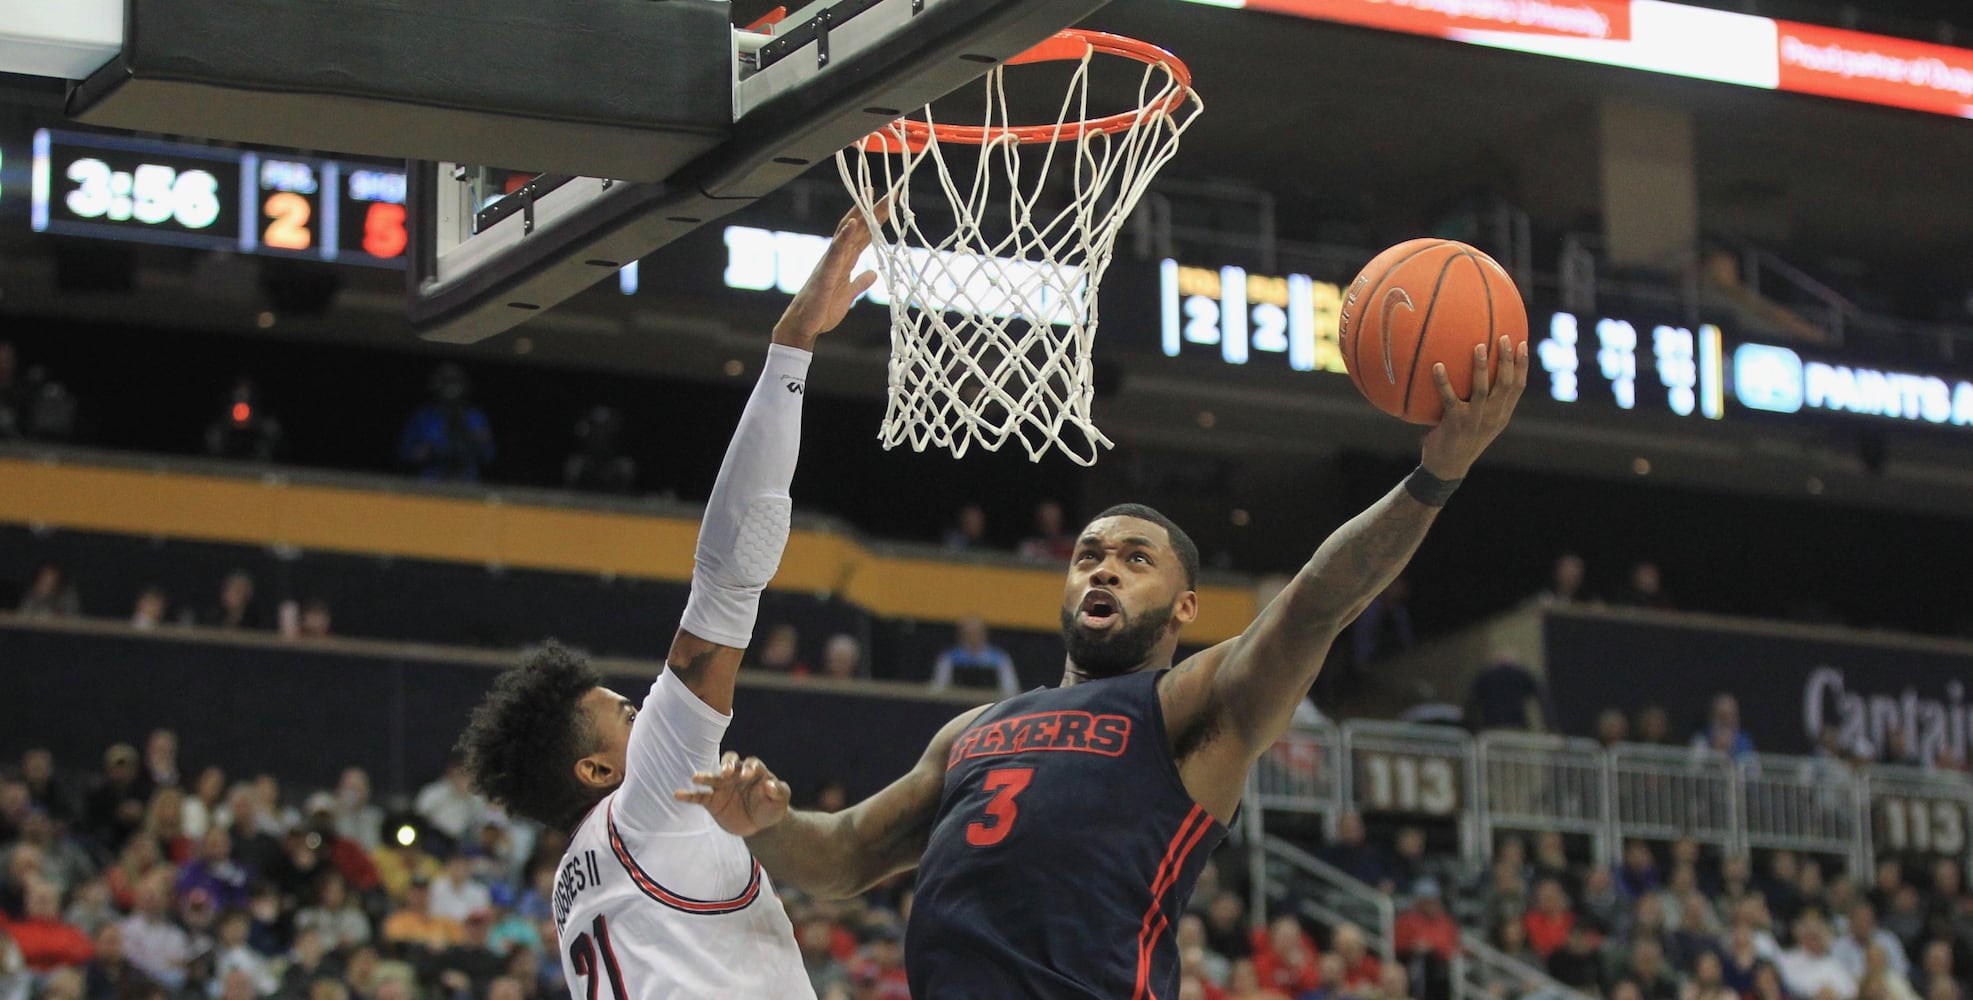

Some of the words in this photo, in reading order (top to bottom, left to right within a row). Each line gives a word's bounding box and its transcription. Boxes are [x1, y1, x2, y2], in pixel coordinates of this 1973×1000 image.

[66, 158, 220, 229] 3:56
[264, 192, 311, 250] 2
[362, 202, 407, 258] 5
[1184, 294, 1221, 345] 2
[1251, 303, 1289, 353] 2
[1806, 362, 1951, 424] PAINTS
[947, 710, 1132, 771] FLYERS
[1804, 666, 1973, 772] Captai
[966, 767, 1034, 847] 3
[1368, 755, 1457, 815] 113
[1886, 800, 1964, 855] 113
[569, 912, 630, 1000] 21
